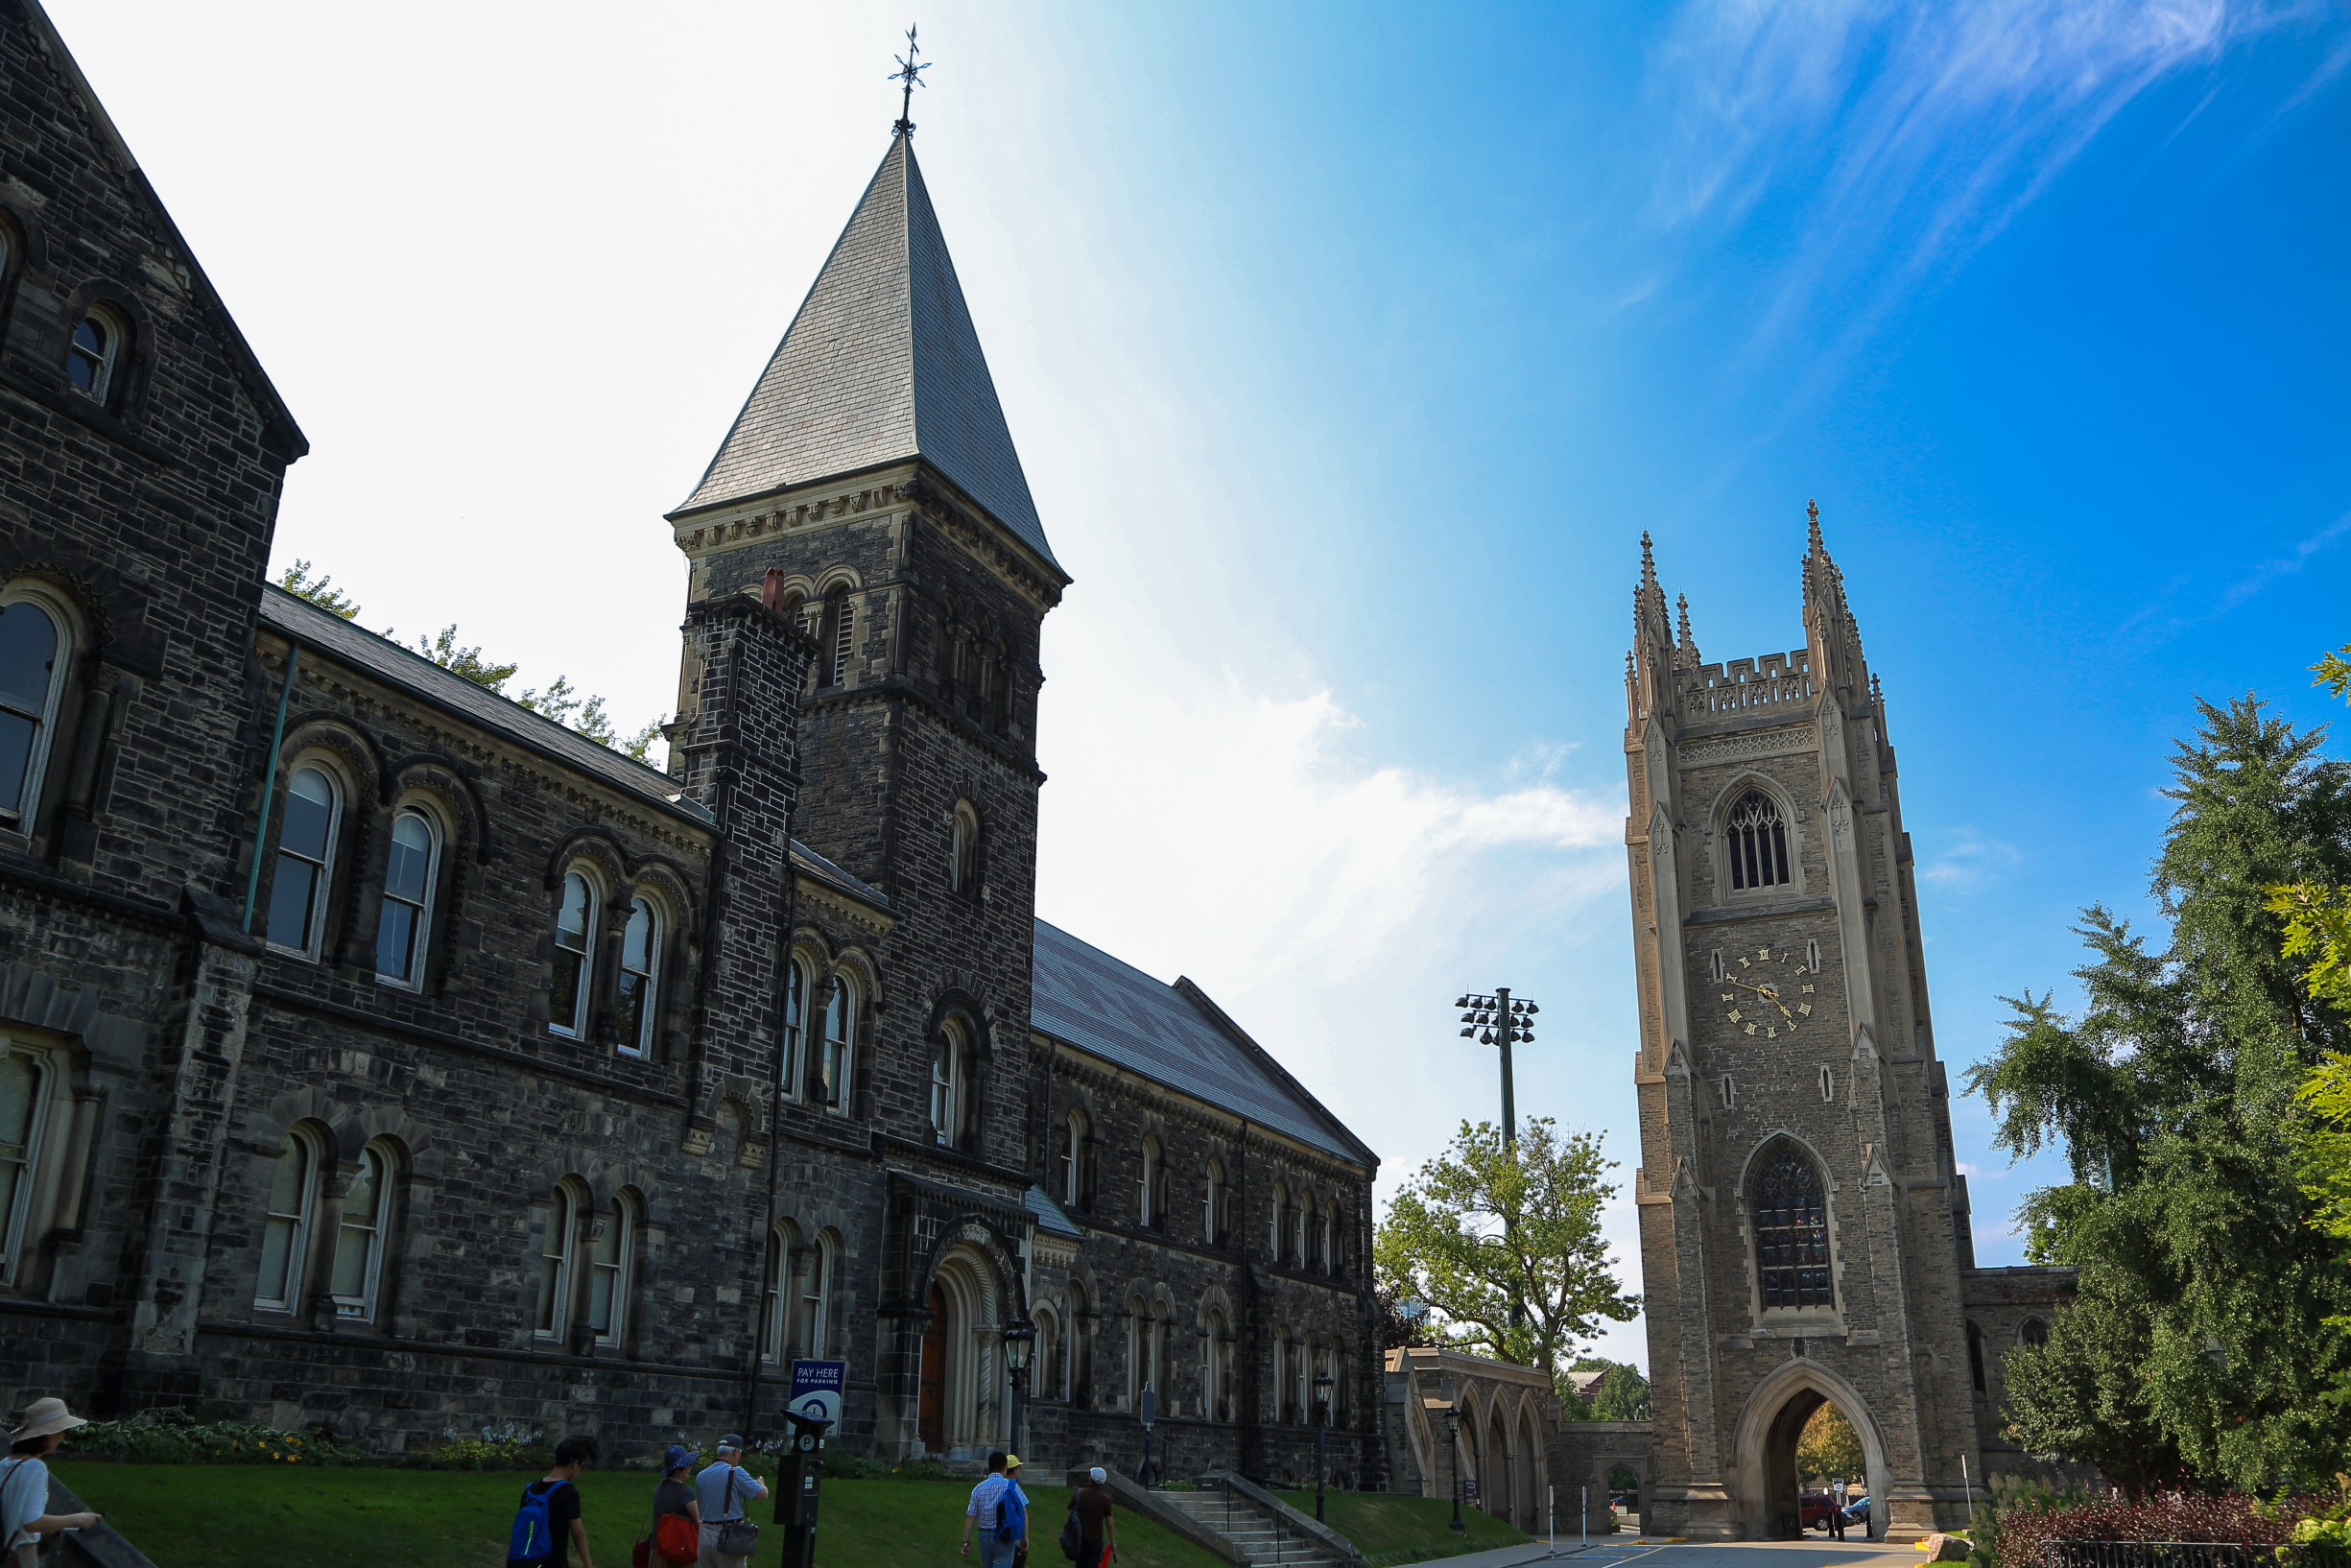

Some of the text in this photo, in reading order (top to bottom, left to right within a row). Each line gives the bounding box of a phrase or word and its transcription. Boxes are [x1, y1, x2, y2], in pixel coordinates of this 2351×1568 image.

[1758, 948, 1769, 961] XII
[1781, 953, 1789, 962] I
[1739, 957, 1751, 968] XI
[1794, 964, 1807, 976] II
[1726, 972, 1738, 983] X
[1802, 984, 1815, 993] III
[1722, 993, 1734, 1002] IX
[1727, 1009, 1743, 1023] VIII
[1745, 1022, 1757, 1035] VII
[1787, 1020, 1797, 1031] V
[1768, 1027, 1777, 1038] VI
[797, 1367, 839, 1378] PAY HERE
[804, 1437, 811, 1447] P
